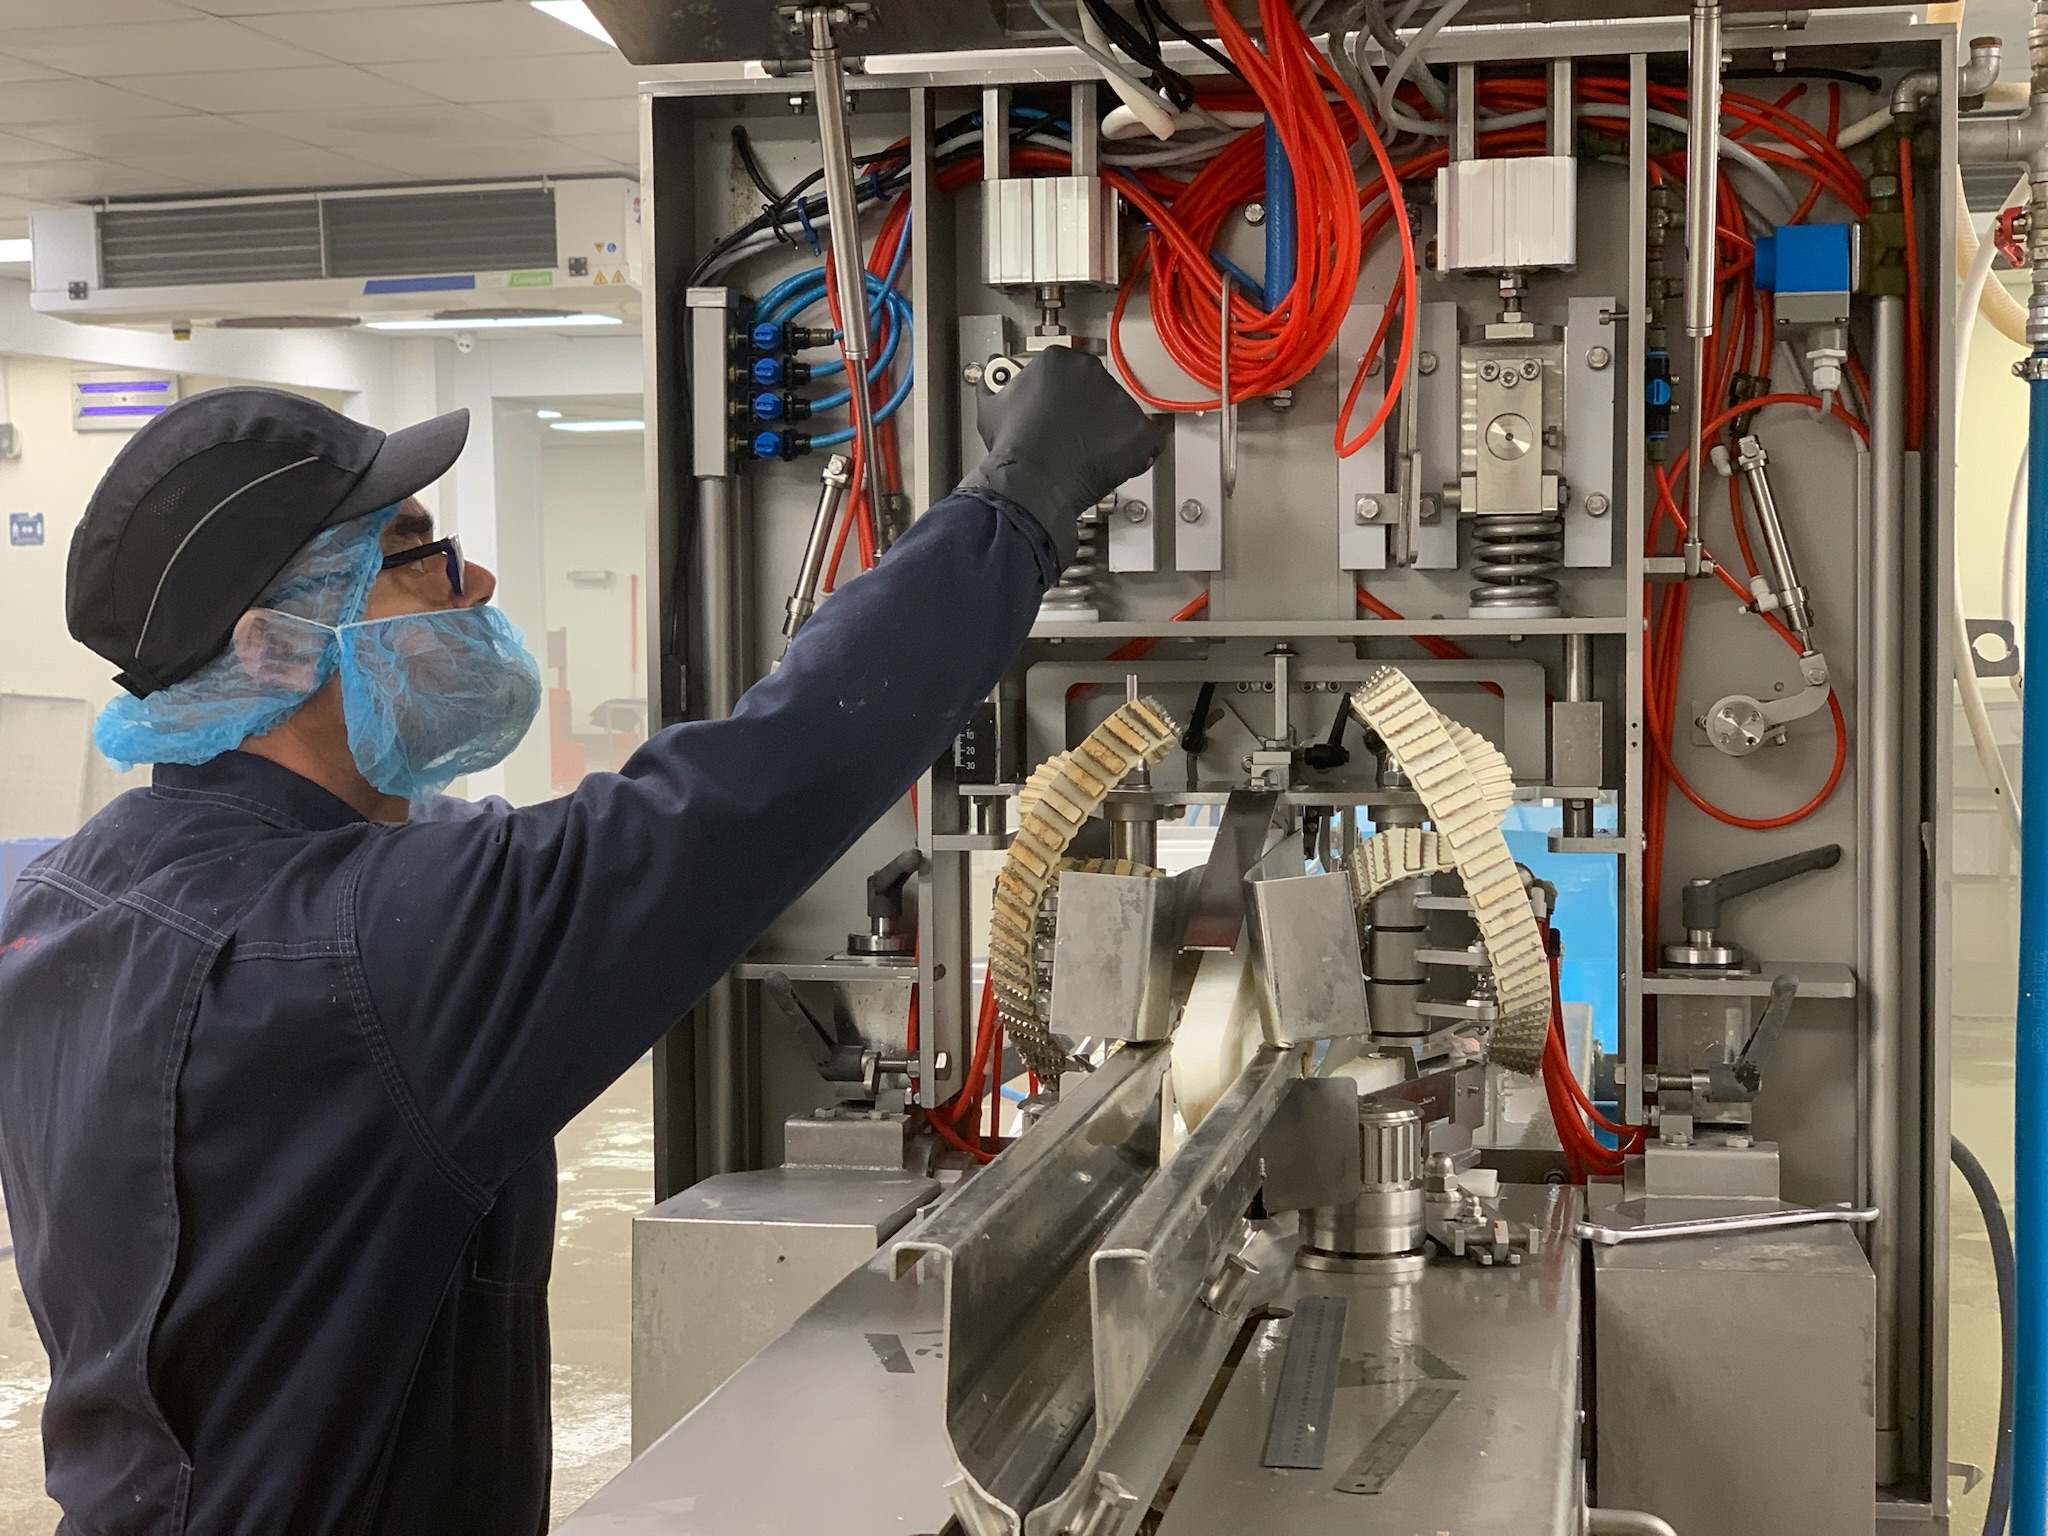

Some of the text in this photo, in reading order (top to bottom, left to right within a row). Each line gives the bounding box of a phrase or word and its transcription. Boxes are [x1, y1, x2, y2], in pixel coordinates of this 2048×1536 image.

[965, 731, 975, 740] 10
[965, 746, 975, 755] 20
[965, 761, 975, 770] 30
